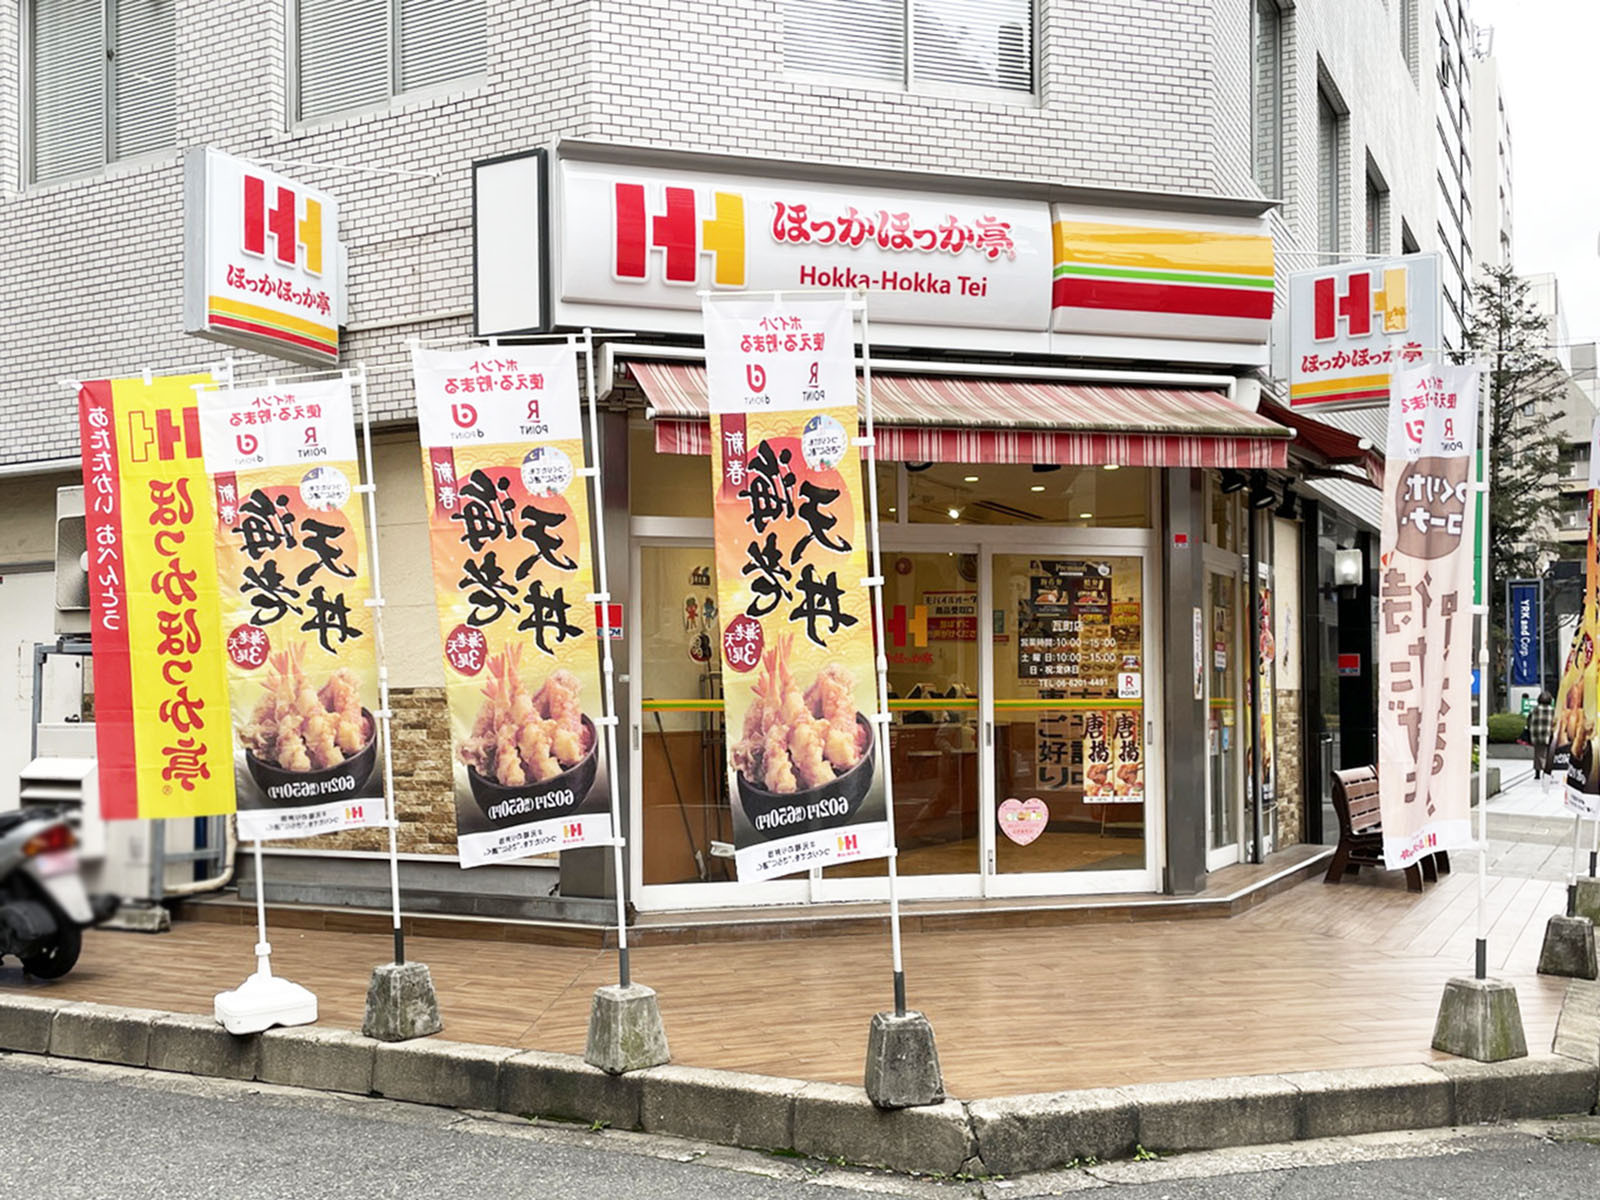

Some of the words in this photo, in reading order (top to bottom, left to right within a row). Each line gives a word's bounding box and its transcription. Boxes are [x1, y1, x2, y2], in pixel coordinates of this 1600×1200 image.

[773, 201, 1014, 259] ほっかほっか亭
[227, 264, 331, 316] ほっかほっか亭
[800, 265, 951, 295] Hokka-Hokka
[958, 275, 988, 297] Tei
[1052, 619, 1084, 632] 瓦町店
[1520, 599, 1530, 619] YRK
[1120, 689, 1139, 697] POINT
[1081, 713, 1109, 763] 唐揚
[1113, 713, 1140, 763] 唐揚
